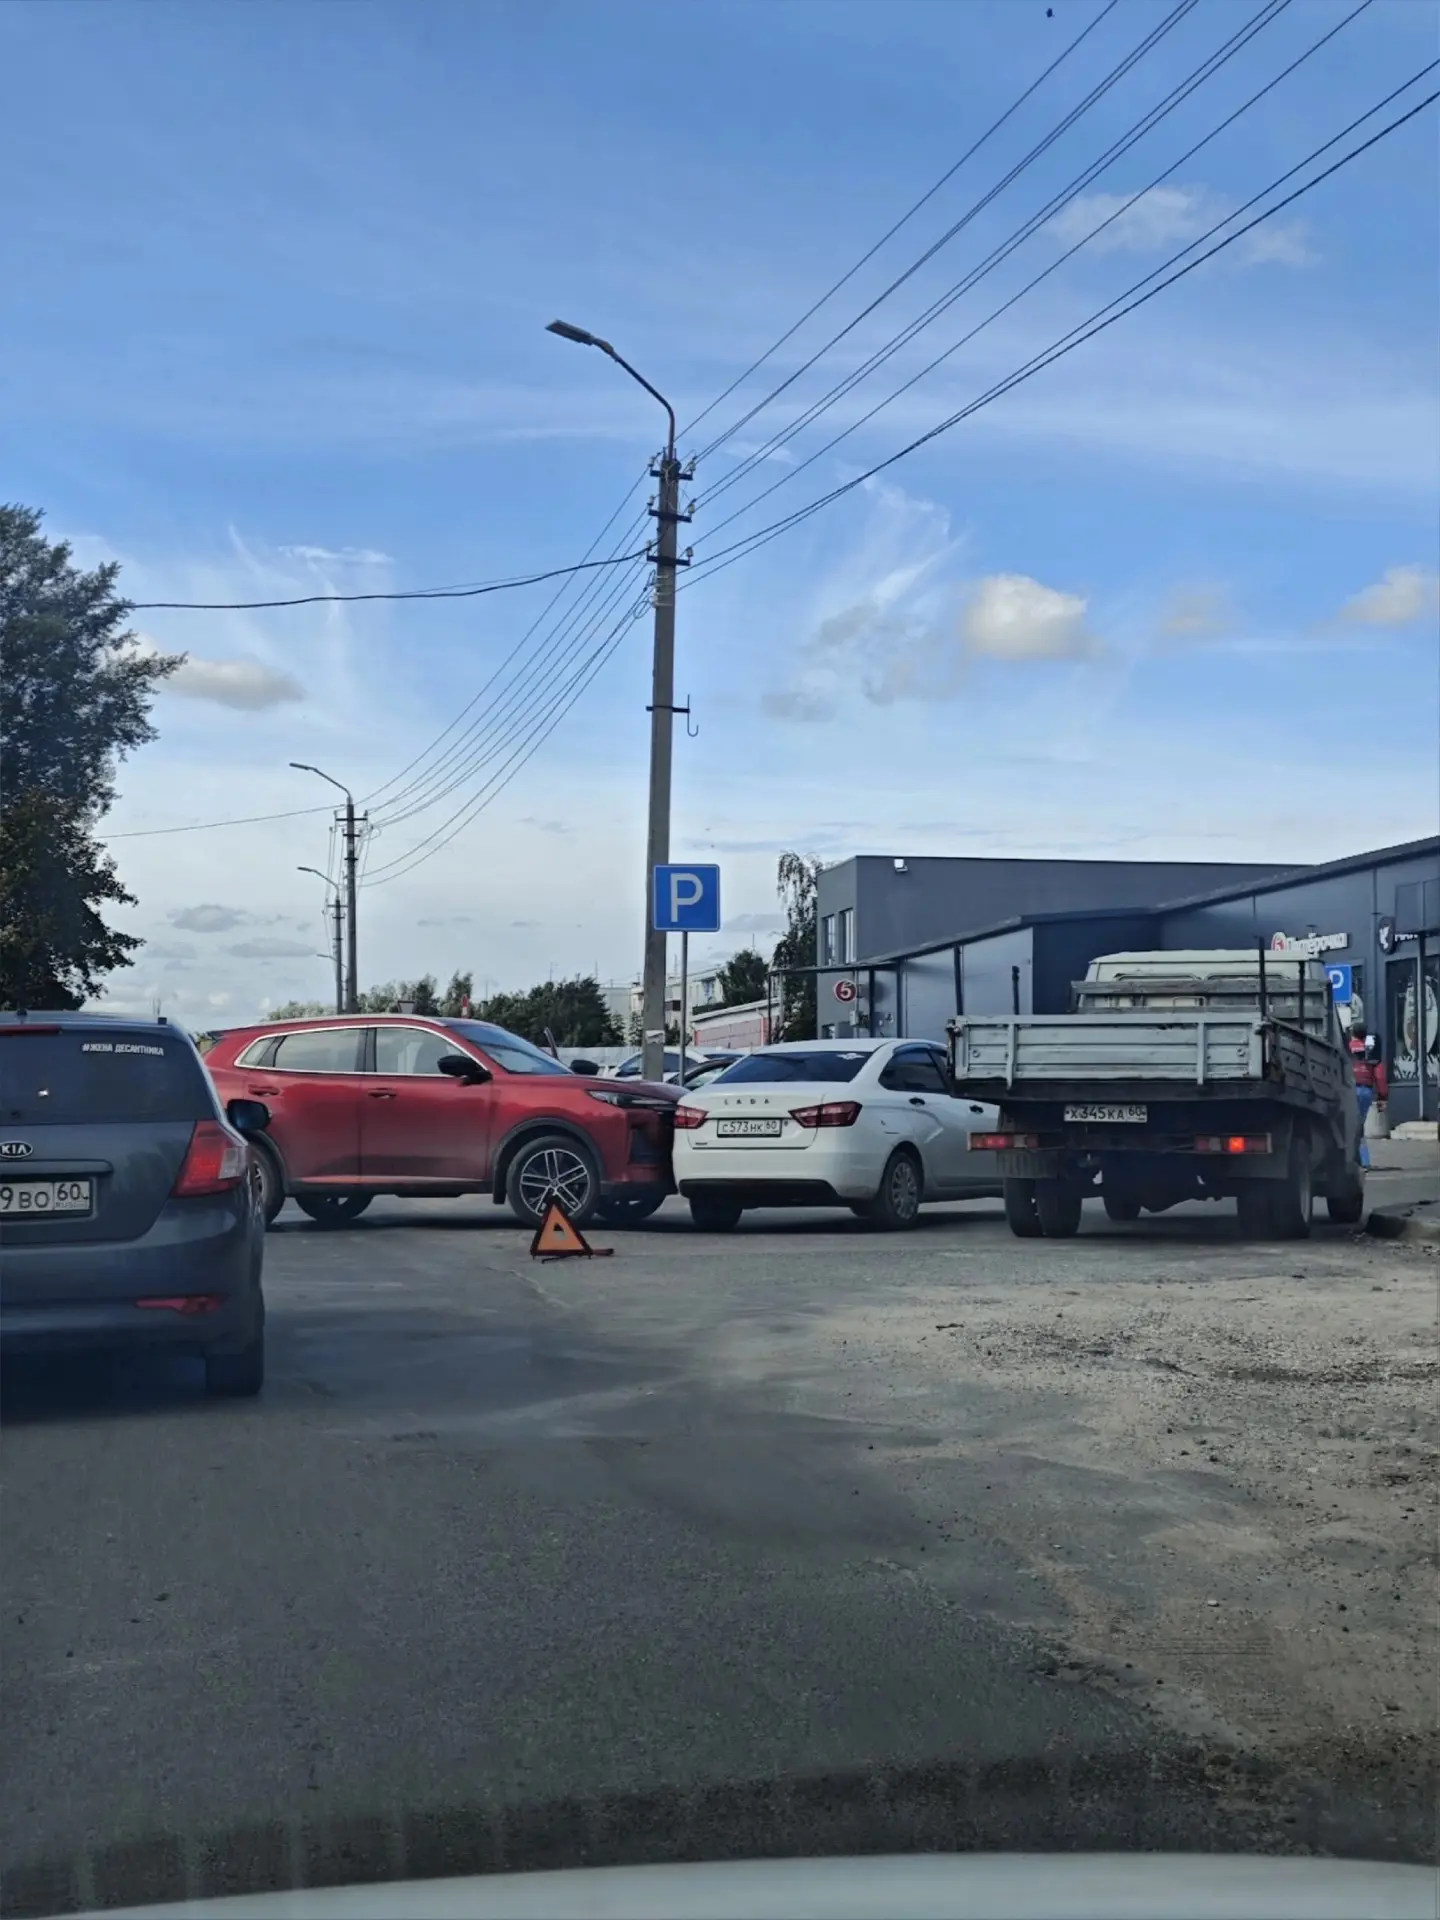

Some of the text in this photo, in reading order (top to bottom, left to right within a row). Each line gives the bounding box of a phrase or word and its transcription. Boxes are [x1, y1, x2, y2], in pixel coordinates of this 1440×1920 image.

[670, 872, 703, 922] P
[82, 1043, 113, 1053] #ЖЕНА
[1, 1144, 28, 1154] KIA
[57, 1183, 81, 1201] 60
